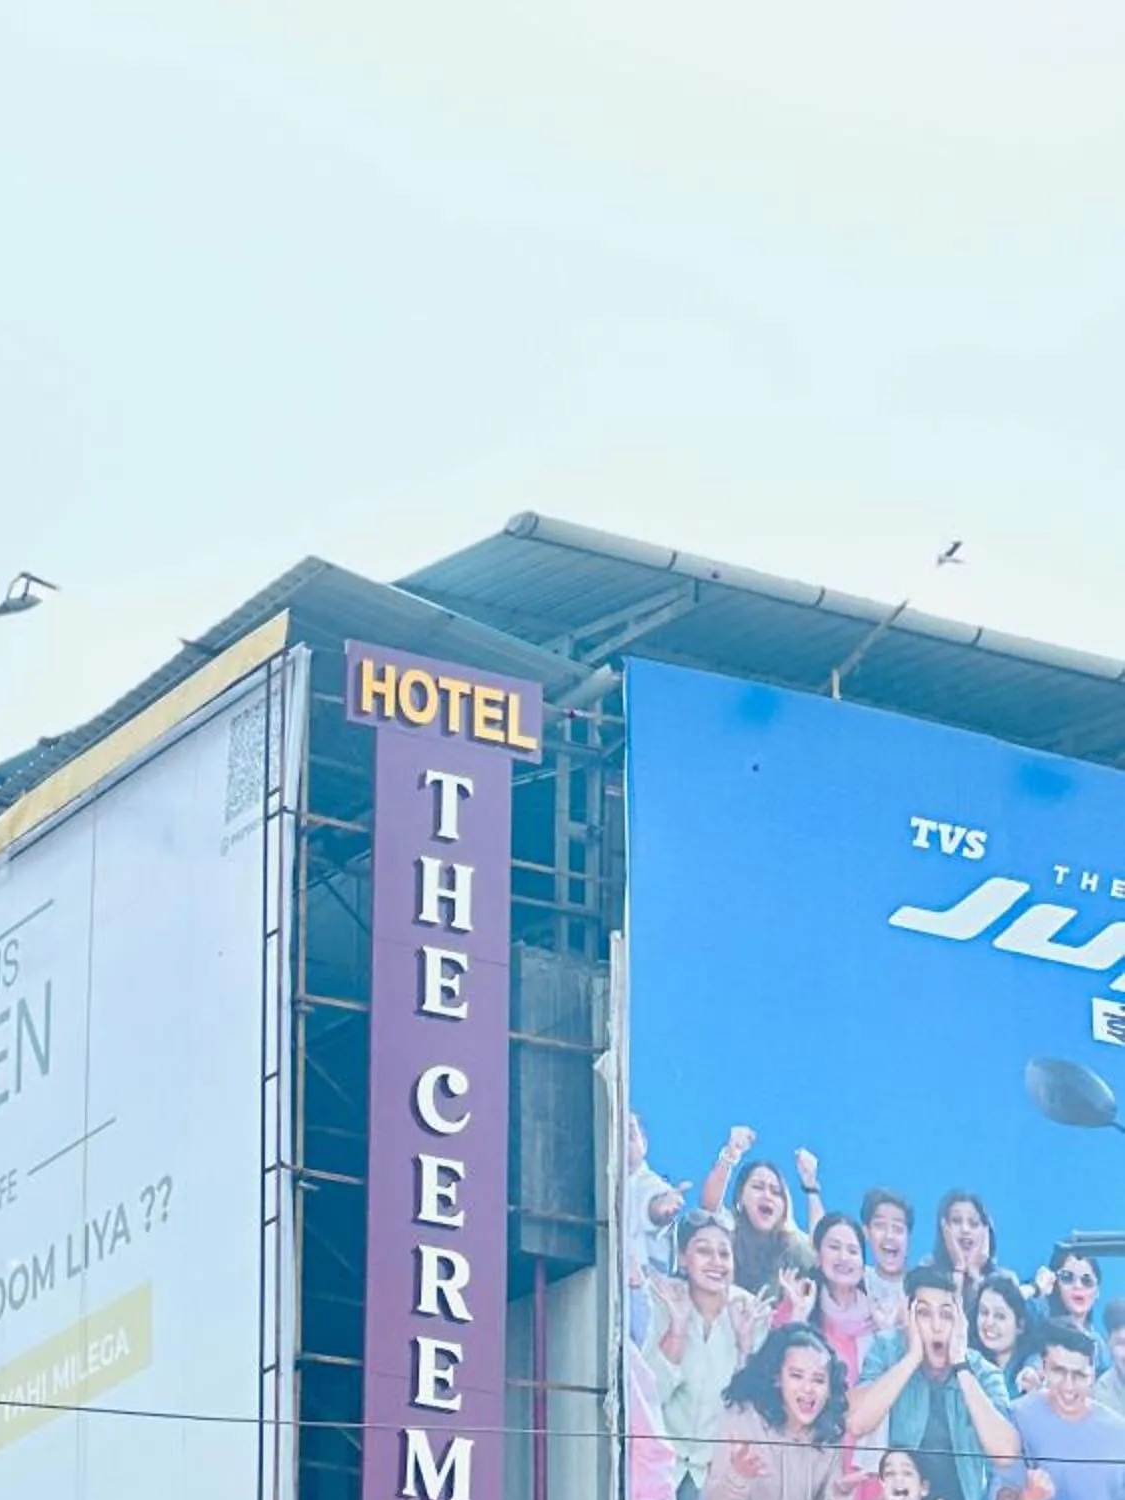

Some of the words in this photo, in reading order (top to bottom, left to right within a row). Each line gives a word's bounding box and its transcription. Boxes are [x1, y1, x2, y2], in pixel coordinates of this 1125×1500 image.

[360, 657, 539, 750] HOTEL
[910, 816, 988, 860] TVS
[418, 769, 474, 1019] THE
[66, 1202, 132, 1281] LIYA
[0, 1368, 48, 1424] YAHI
[51, 1325, 133, 1396] MILEGA
